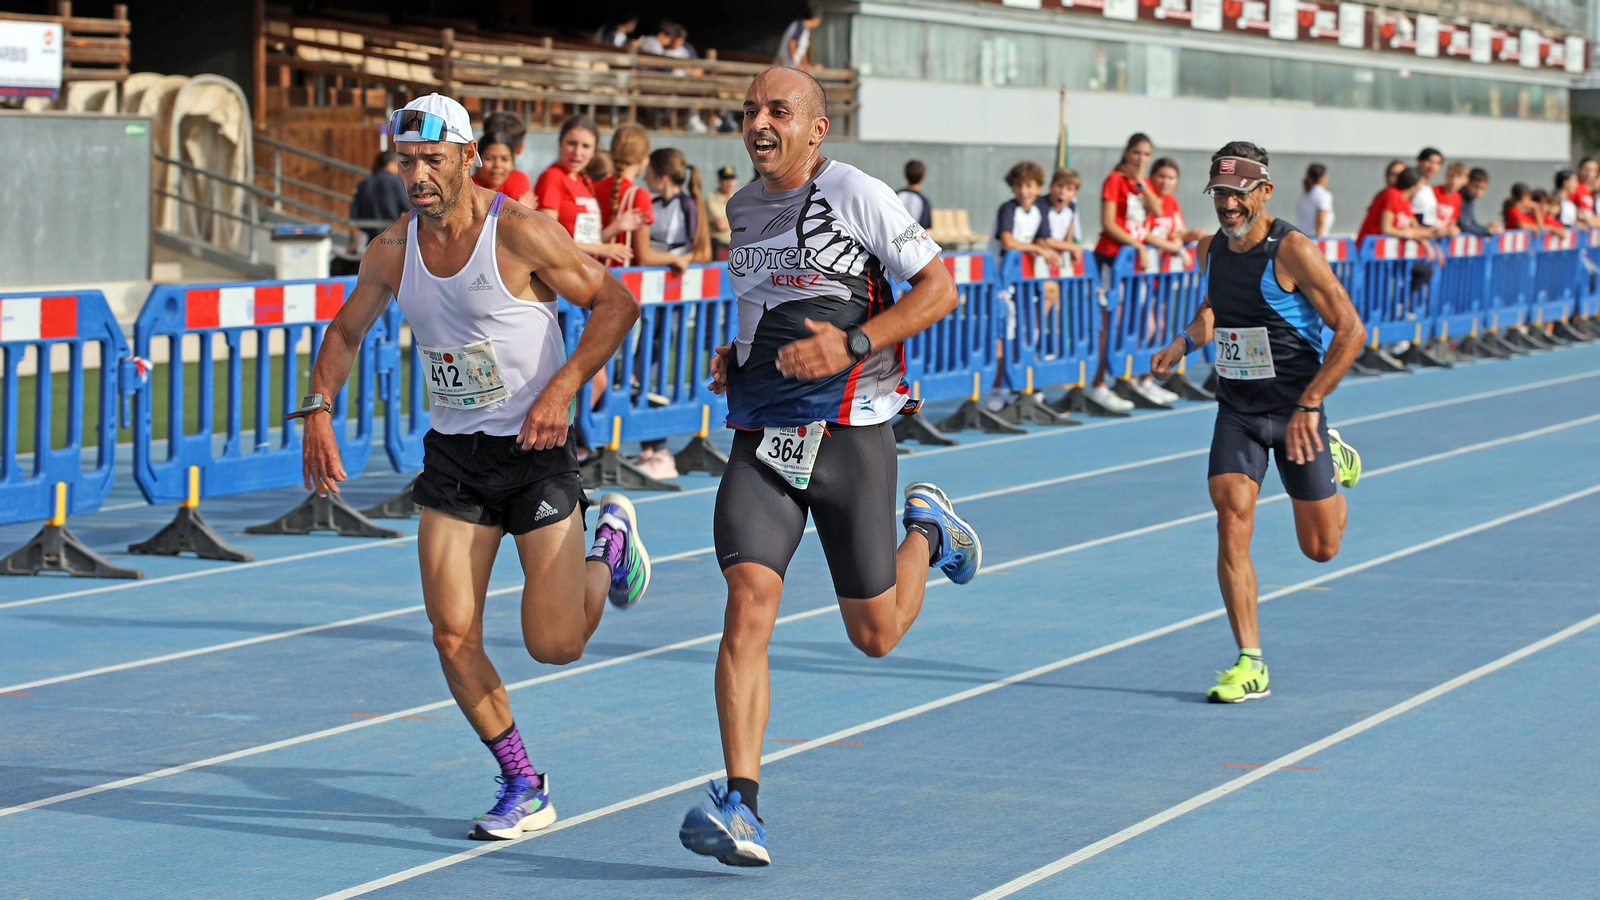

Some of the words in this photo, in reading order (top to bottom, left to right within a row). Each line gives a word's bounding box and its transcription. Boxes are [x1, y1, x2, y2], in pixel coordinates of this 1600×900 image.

[1219, 341, 1241, 360] 782
[431, 364, 463, 387] 412
[768, 436, 805, 464] 364
[534, 507, 559, 521] adidas
